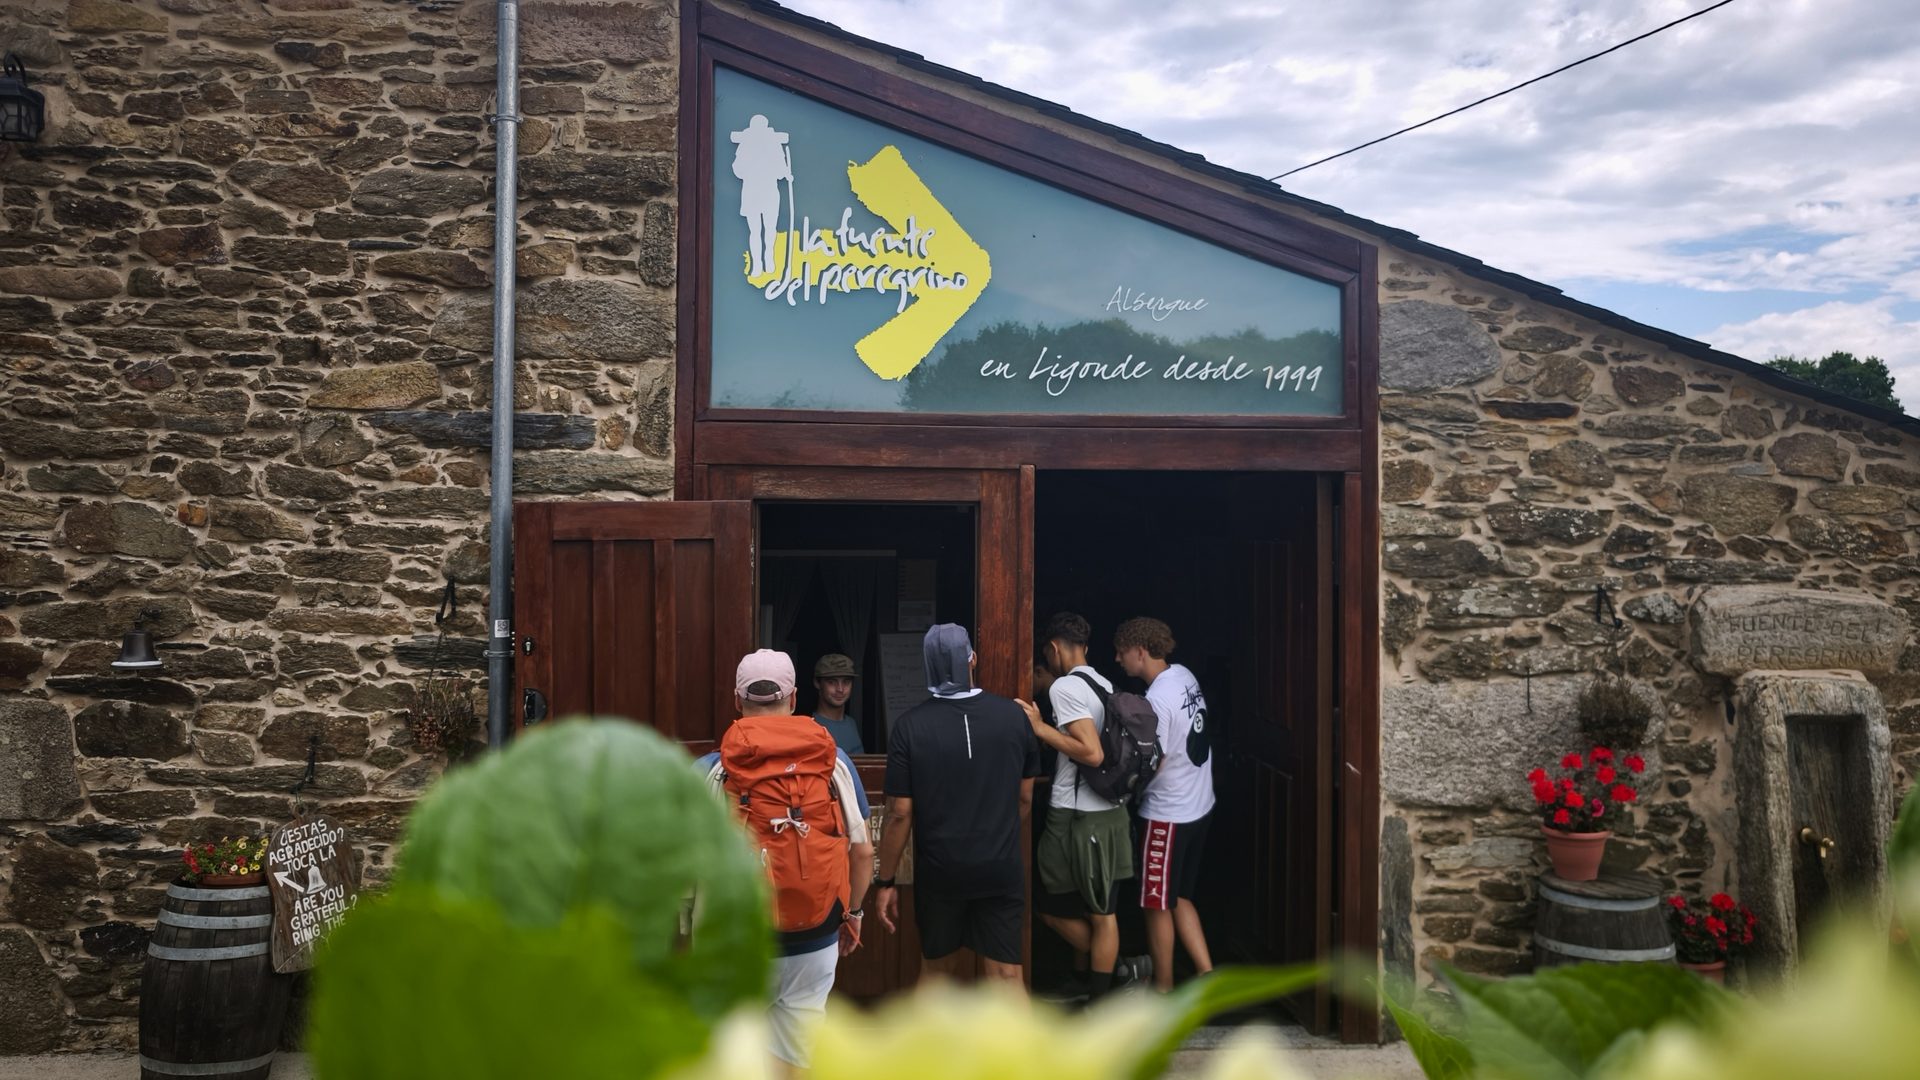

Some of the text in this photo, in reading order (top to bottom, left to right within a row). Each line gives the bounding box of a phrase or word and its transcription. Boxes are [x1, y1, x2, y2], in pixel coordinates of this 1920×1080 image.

[802, 207, 936, 257] la fuente
[765, 262, 969, 314] del peregrino
[1106, 285, 1209, 321] Albergue
[980, 347, 1323, 396] en Ligonde desde 1999
[1729, 614, 1817, 634] FUENTE
[269, 827, 344, 866] AGRADECIDO?
[280, 819, 327, 846] ¿ESTAS
[283, 845, 337, 874] TOCA LA
[1148, 828, 1167, 881] ORDAN
[294, 885, 345, 915] ARE YOU
[292, 913, 347, 946] RING THE
